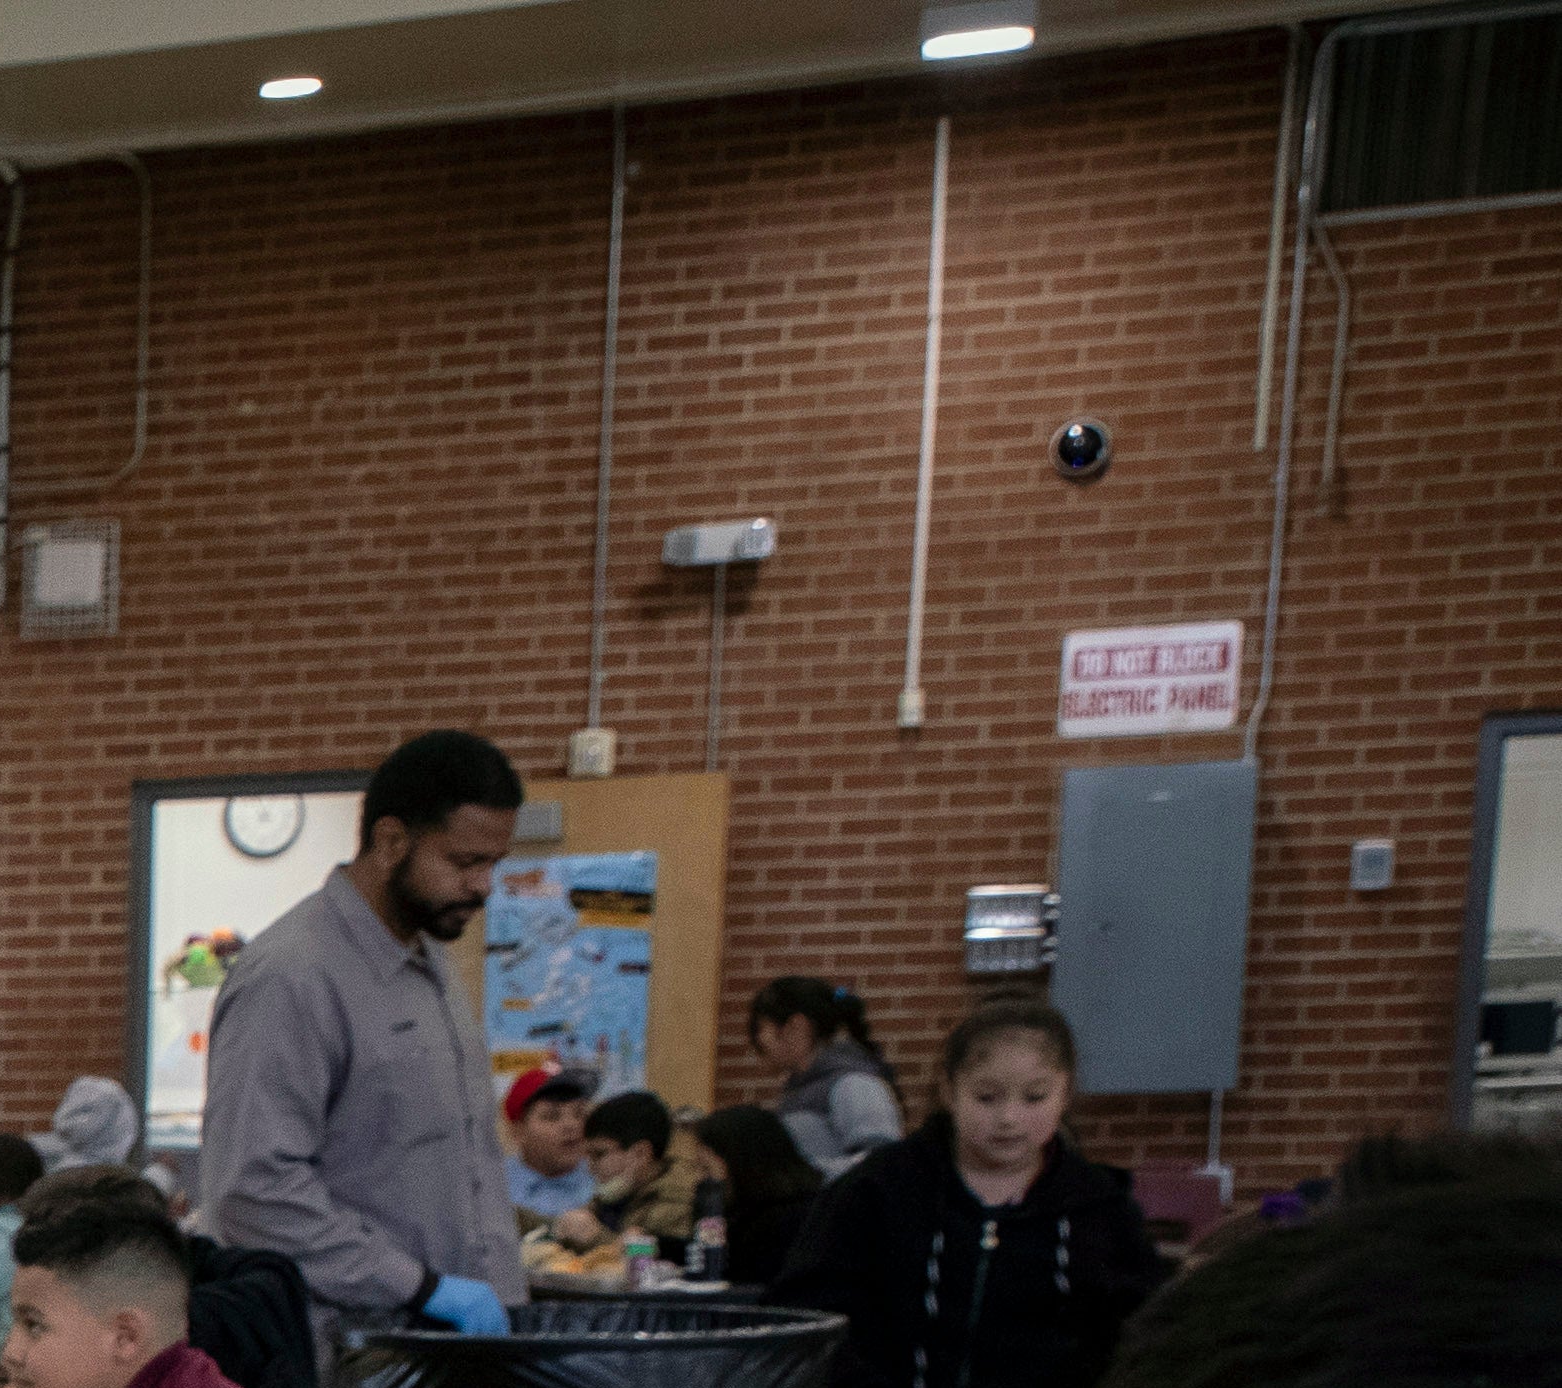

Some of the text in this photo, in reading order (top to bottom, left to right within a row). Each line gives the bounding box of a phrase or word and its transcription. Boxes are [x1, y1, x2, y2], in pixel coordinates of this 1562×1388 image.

[1114, 647, 1150, 676] NOT
[1158, 643, 1222, 673] BLOCK
[1062, 683, 1230, 719] ELECTRIC PANEL
